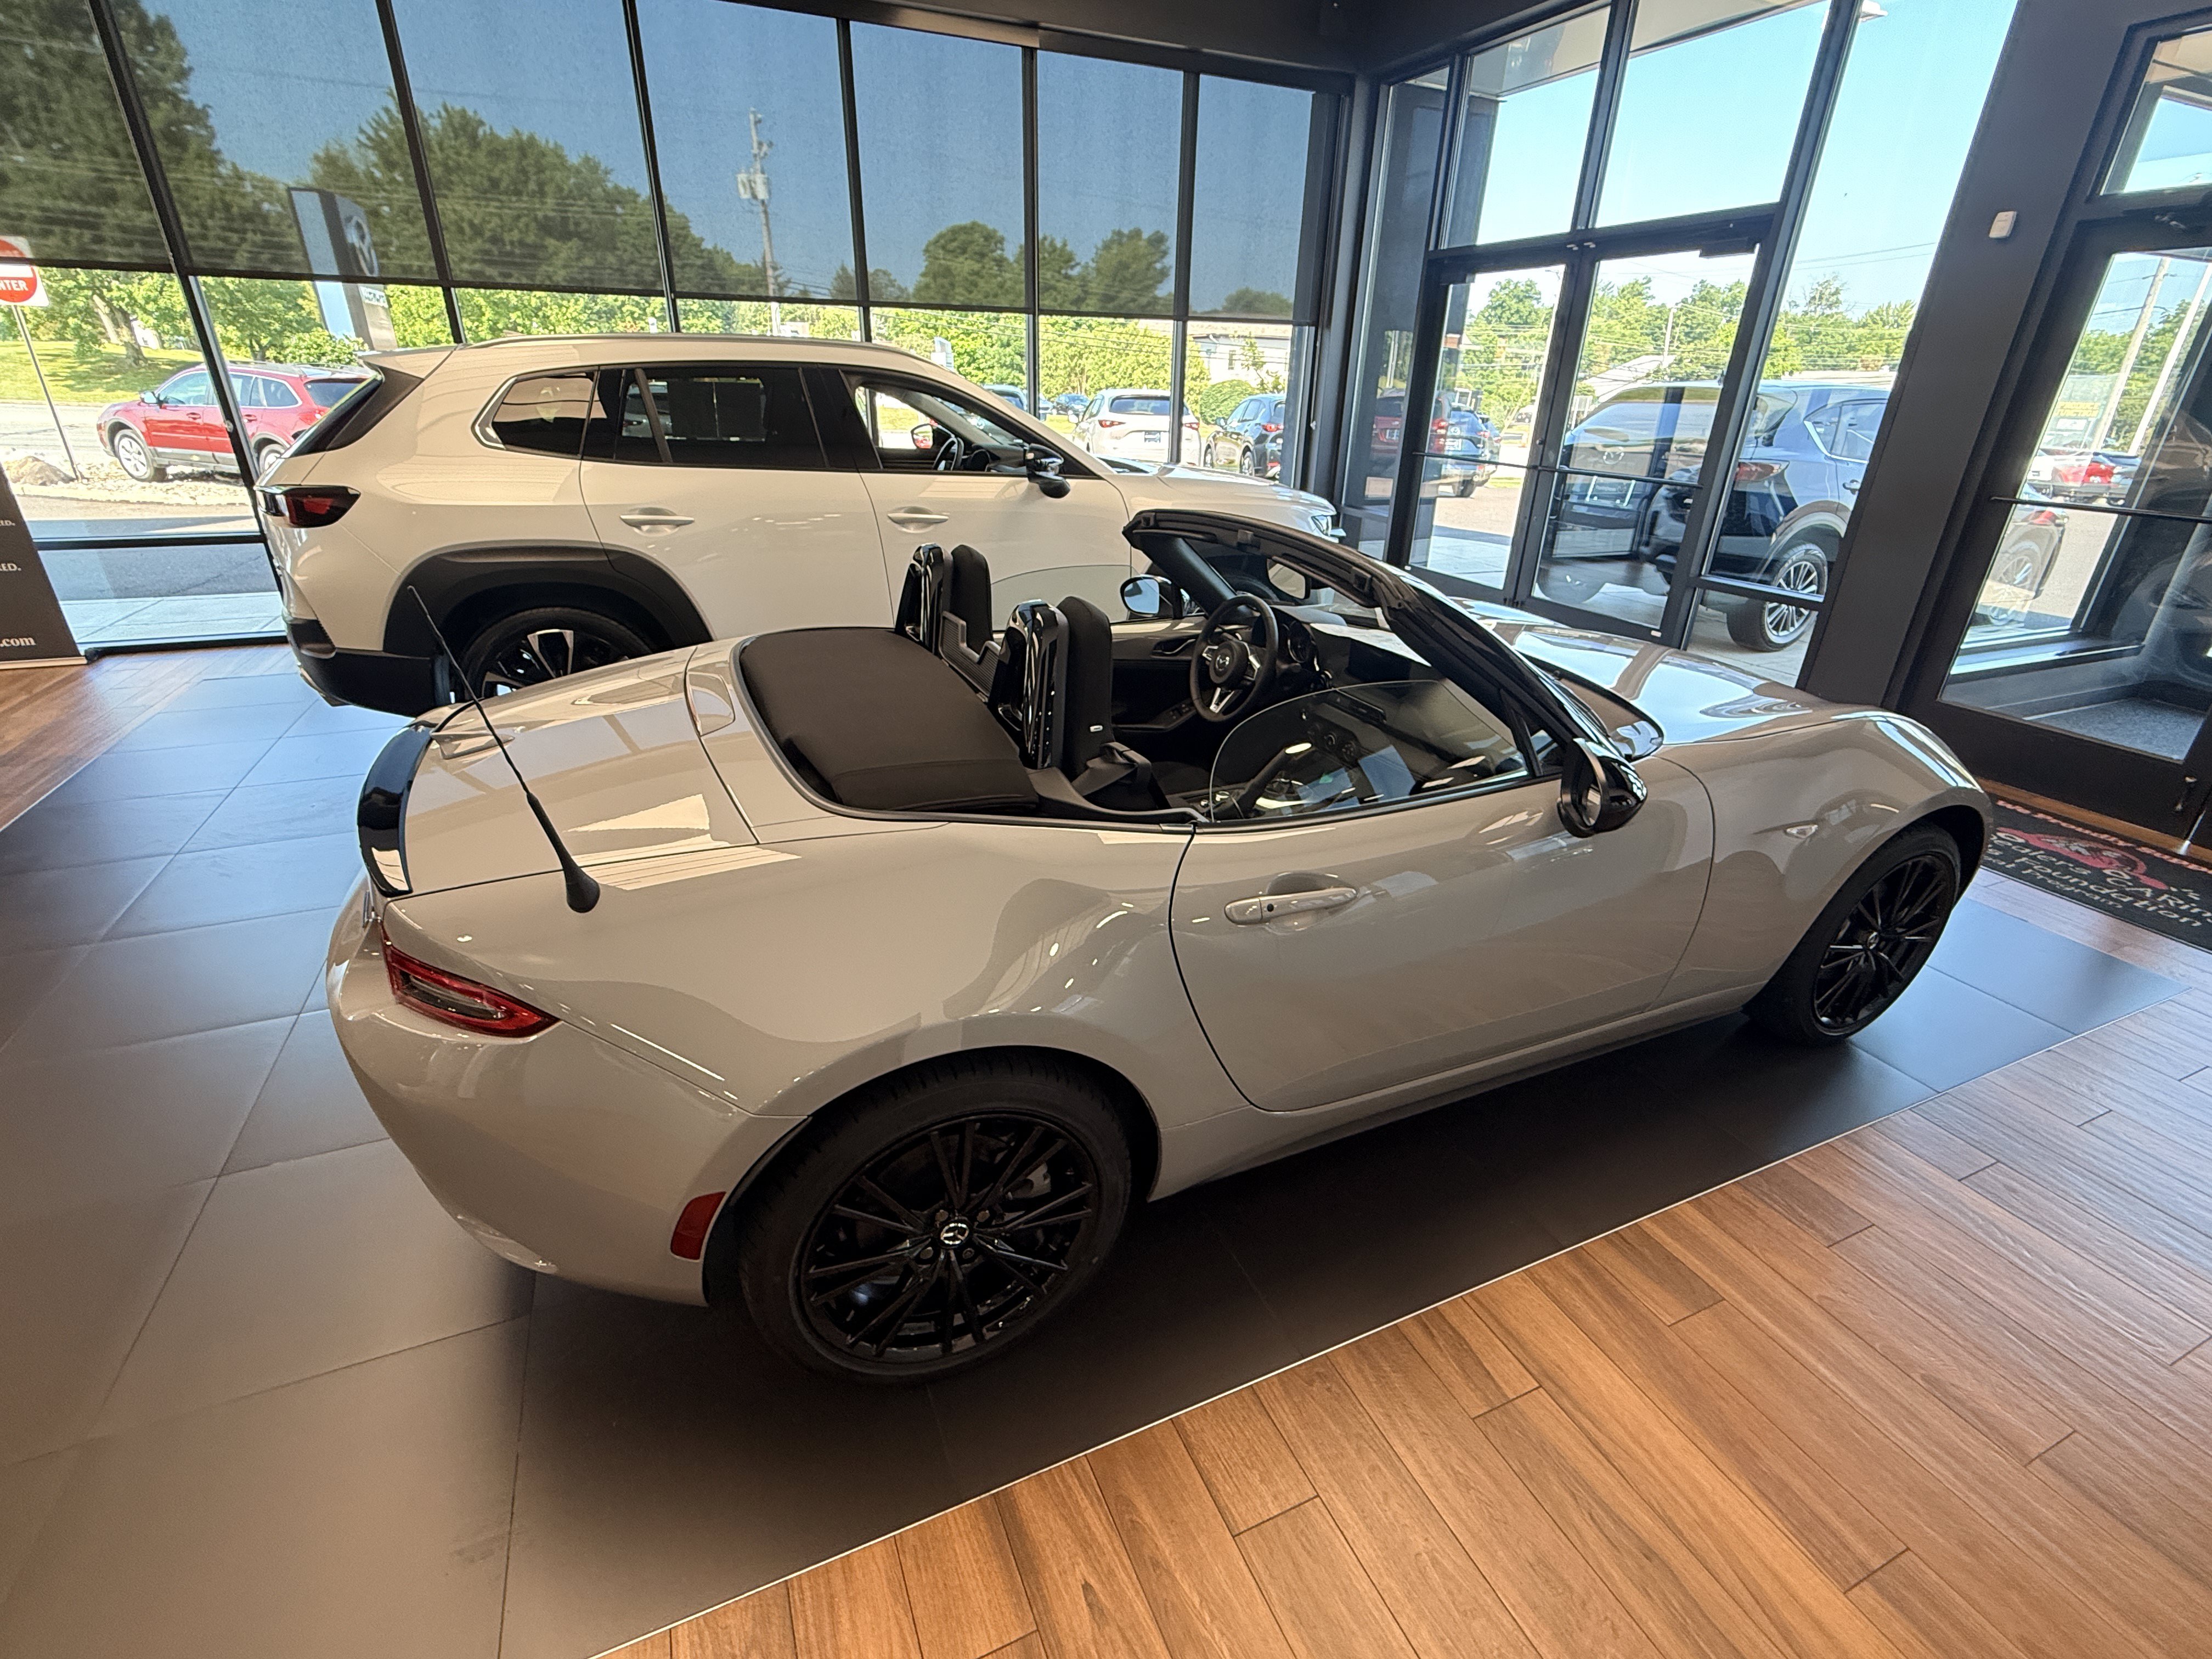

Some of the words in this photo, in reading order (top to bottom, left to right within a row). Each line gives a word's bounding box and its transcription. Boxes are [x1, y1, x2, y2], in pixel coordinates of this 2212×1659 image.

[0, 563, 21, 571] ED.
[2015, 857, 2202, 927] Foundation
[2021, 869, 2123, 909] Program
[2106, 877, 2212, 924] CARin
